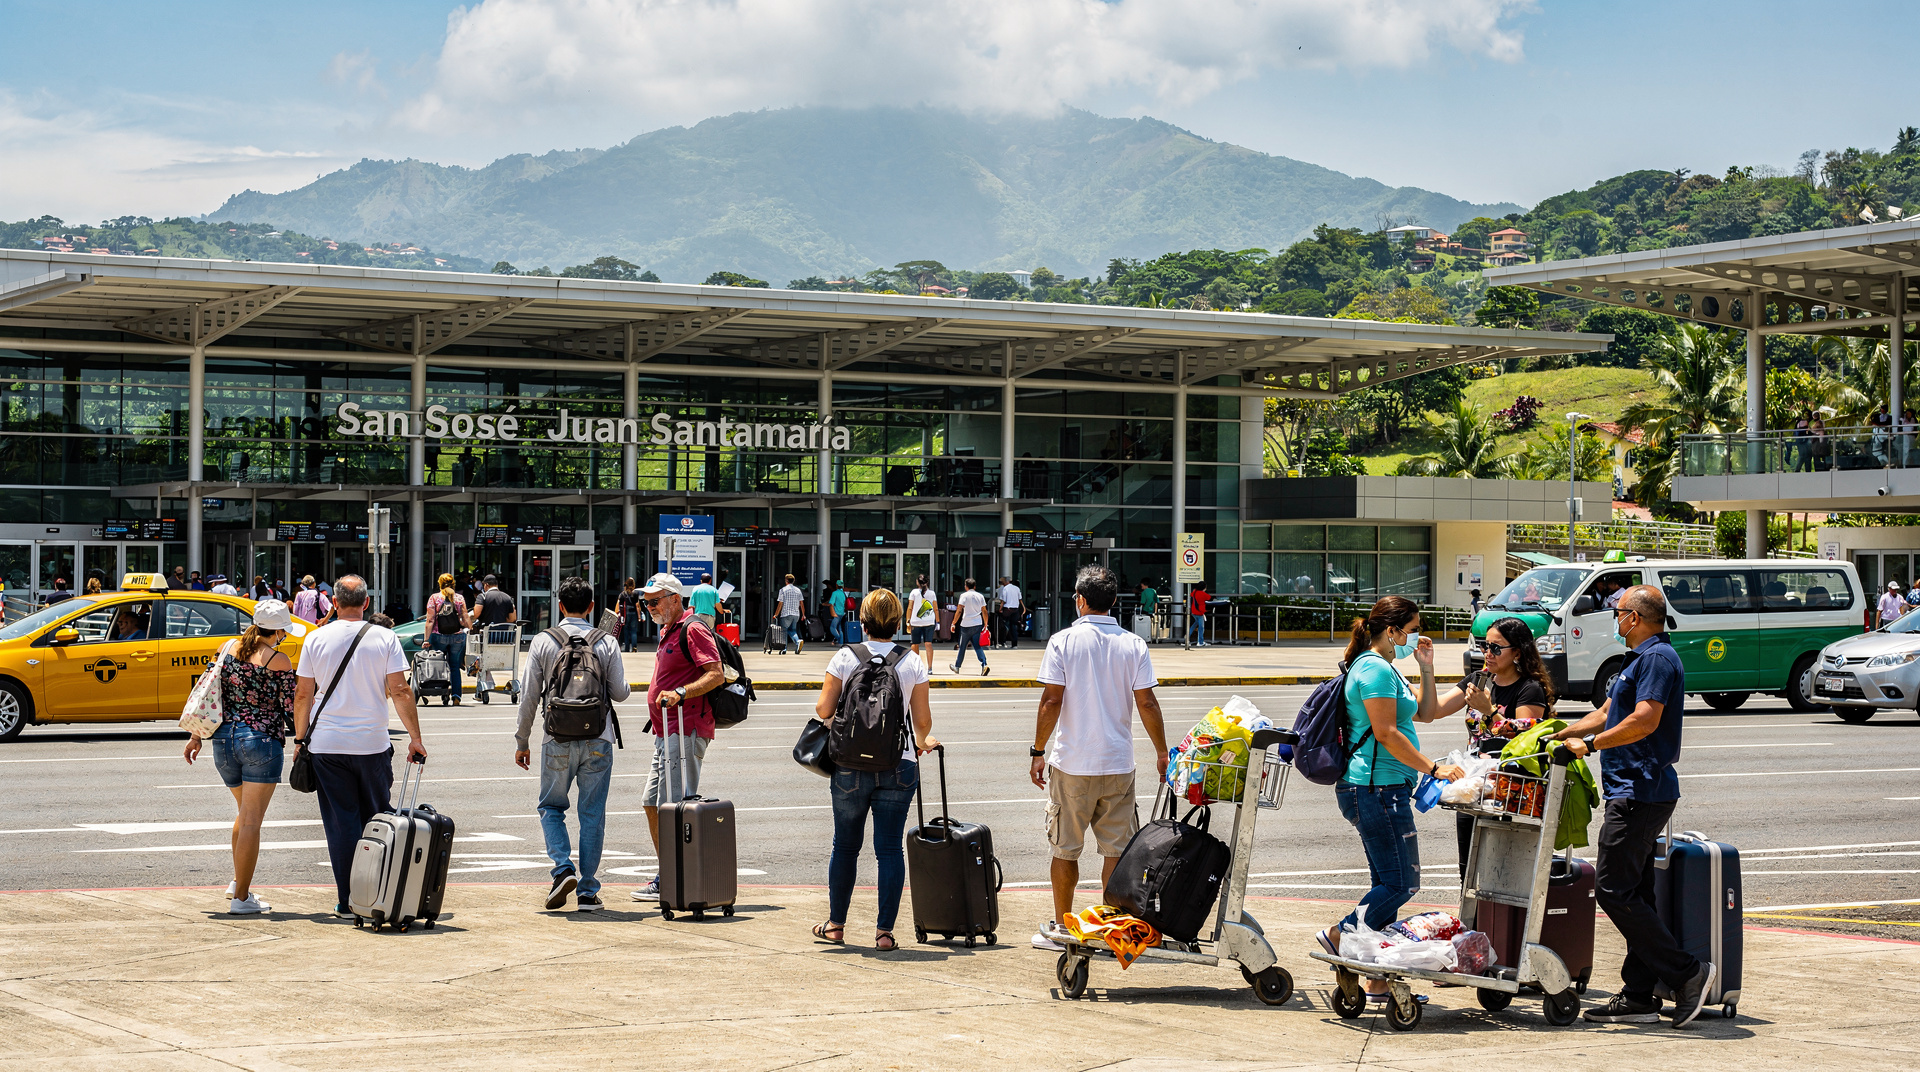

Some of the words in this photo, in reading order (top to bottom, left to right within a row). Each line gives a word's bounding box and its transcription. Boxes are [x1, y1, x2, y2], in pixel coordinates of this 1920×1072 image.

[336, 402, 409, 436] San
[425, 405, 519, 441] Sosé
[547, 409, 638, 443] Juan
[651, 413, 850, 450] Santamaría
